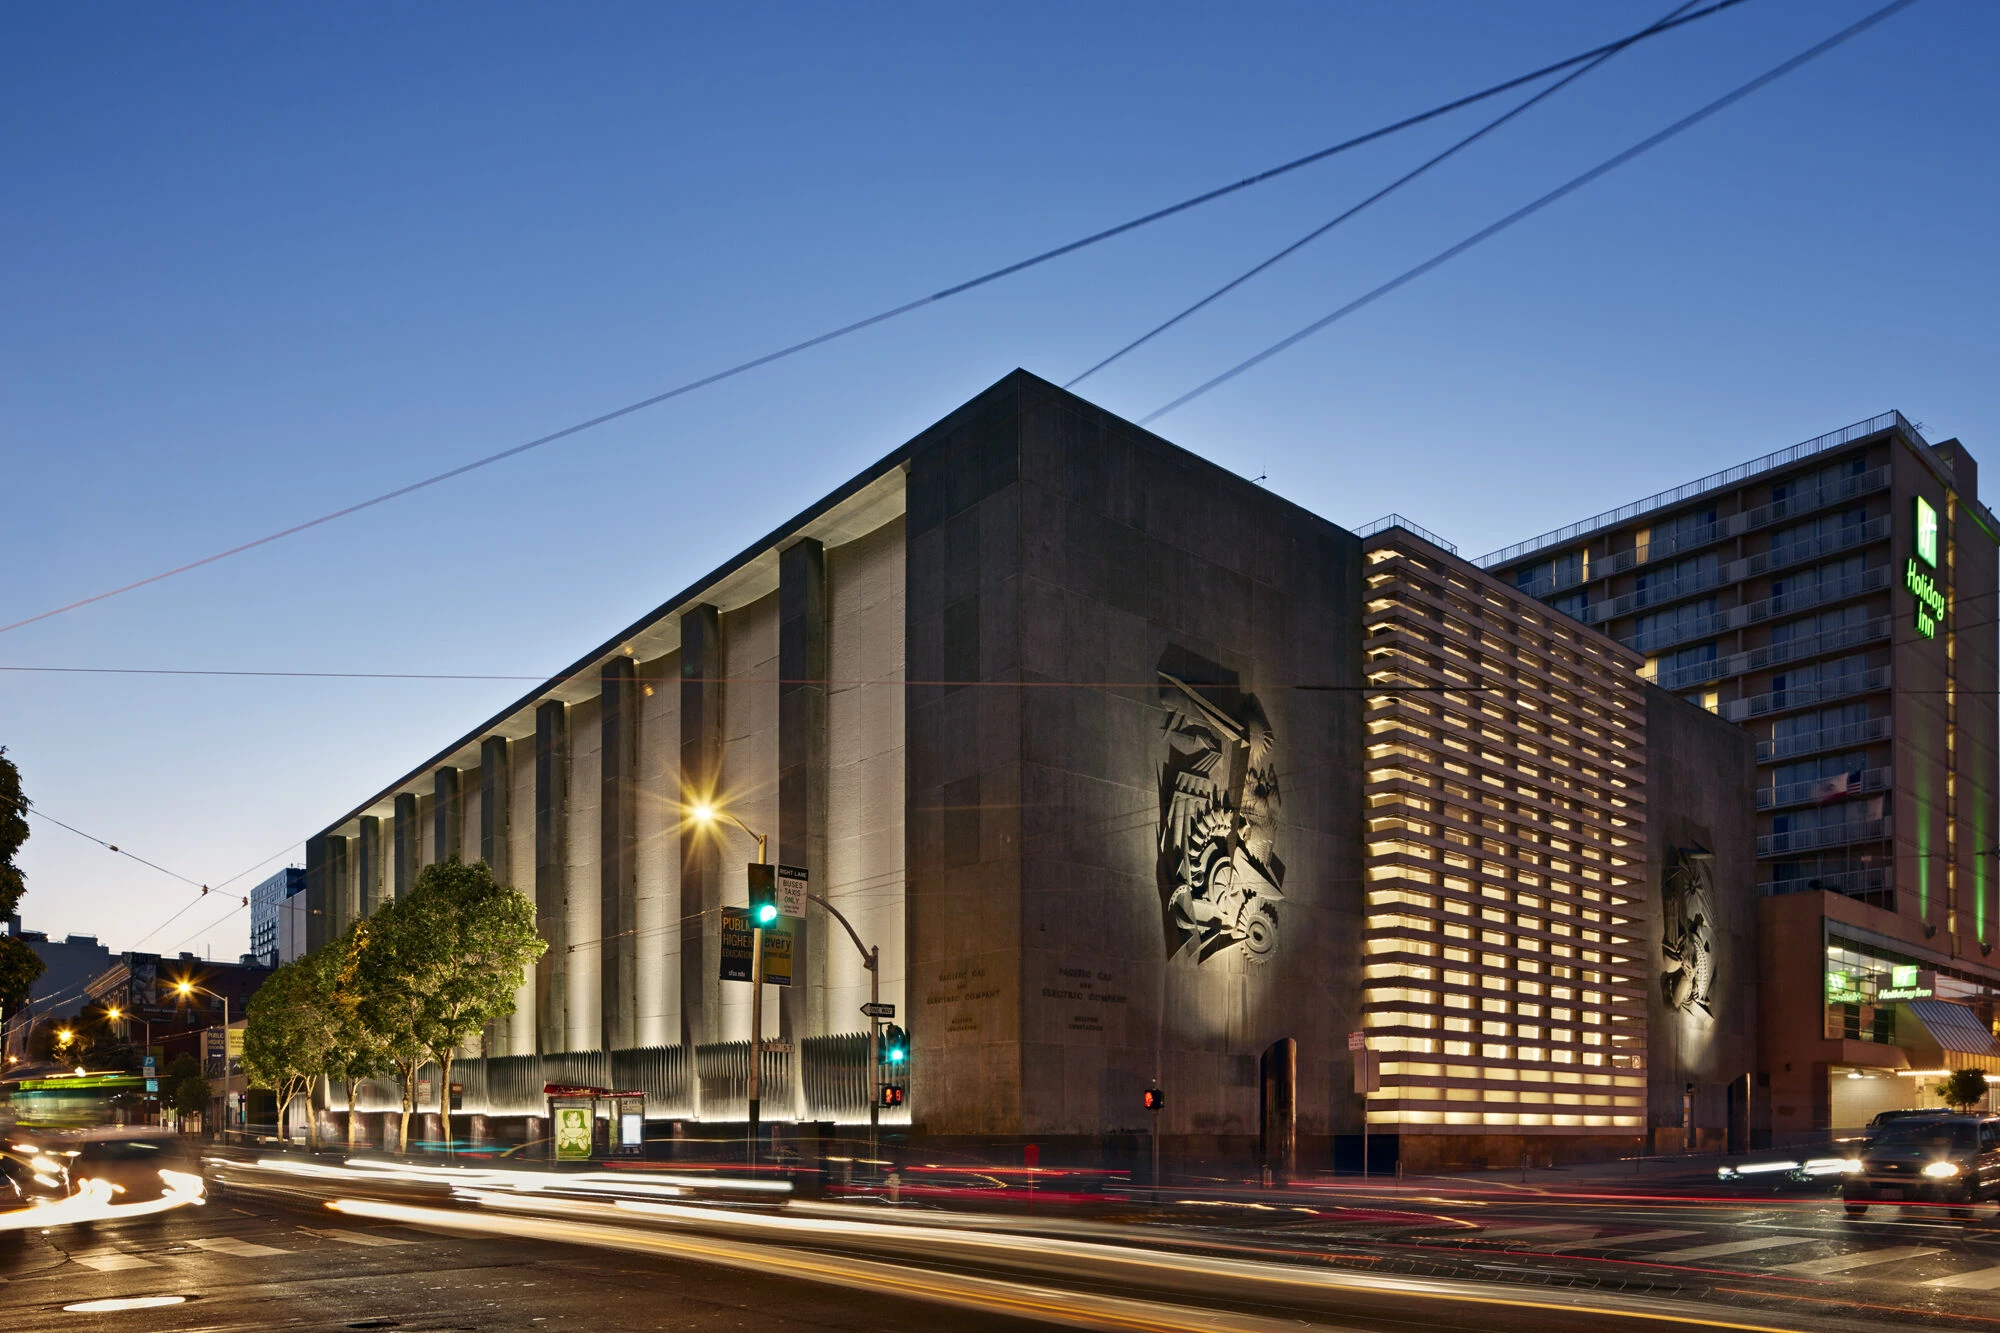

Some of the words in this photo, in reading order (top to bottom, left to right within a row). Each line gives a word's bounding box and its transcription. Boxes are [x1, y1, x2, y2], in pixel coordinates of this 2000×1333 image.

[1907, 557, 1945, 621] Holiday
[1918, 600, 1934, 640] Inn
[780, 868, 793, 876] RIGHT
[794, 871, 807, 879] LANE
[783, 879, 803, 889] BUSES
[784, 887, 801, 897] TAXIS
[784, 896, 800, 905] ONLY
[722, 917, 753, 932] PUBLI
[723, 933, 753, 948] HIGHER
[765, 937, 792, 952] every
[964, 989, 1001, 1001] COMPANY
[1042, 988, 1083, 1000] ELECTRIC
[1088, 992, 1127, 1003] COMPANY
[1879, 988, 1915, 999] Holiday
[1915, 987, 1932, 996] Inn
